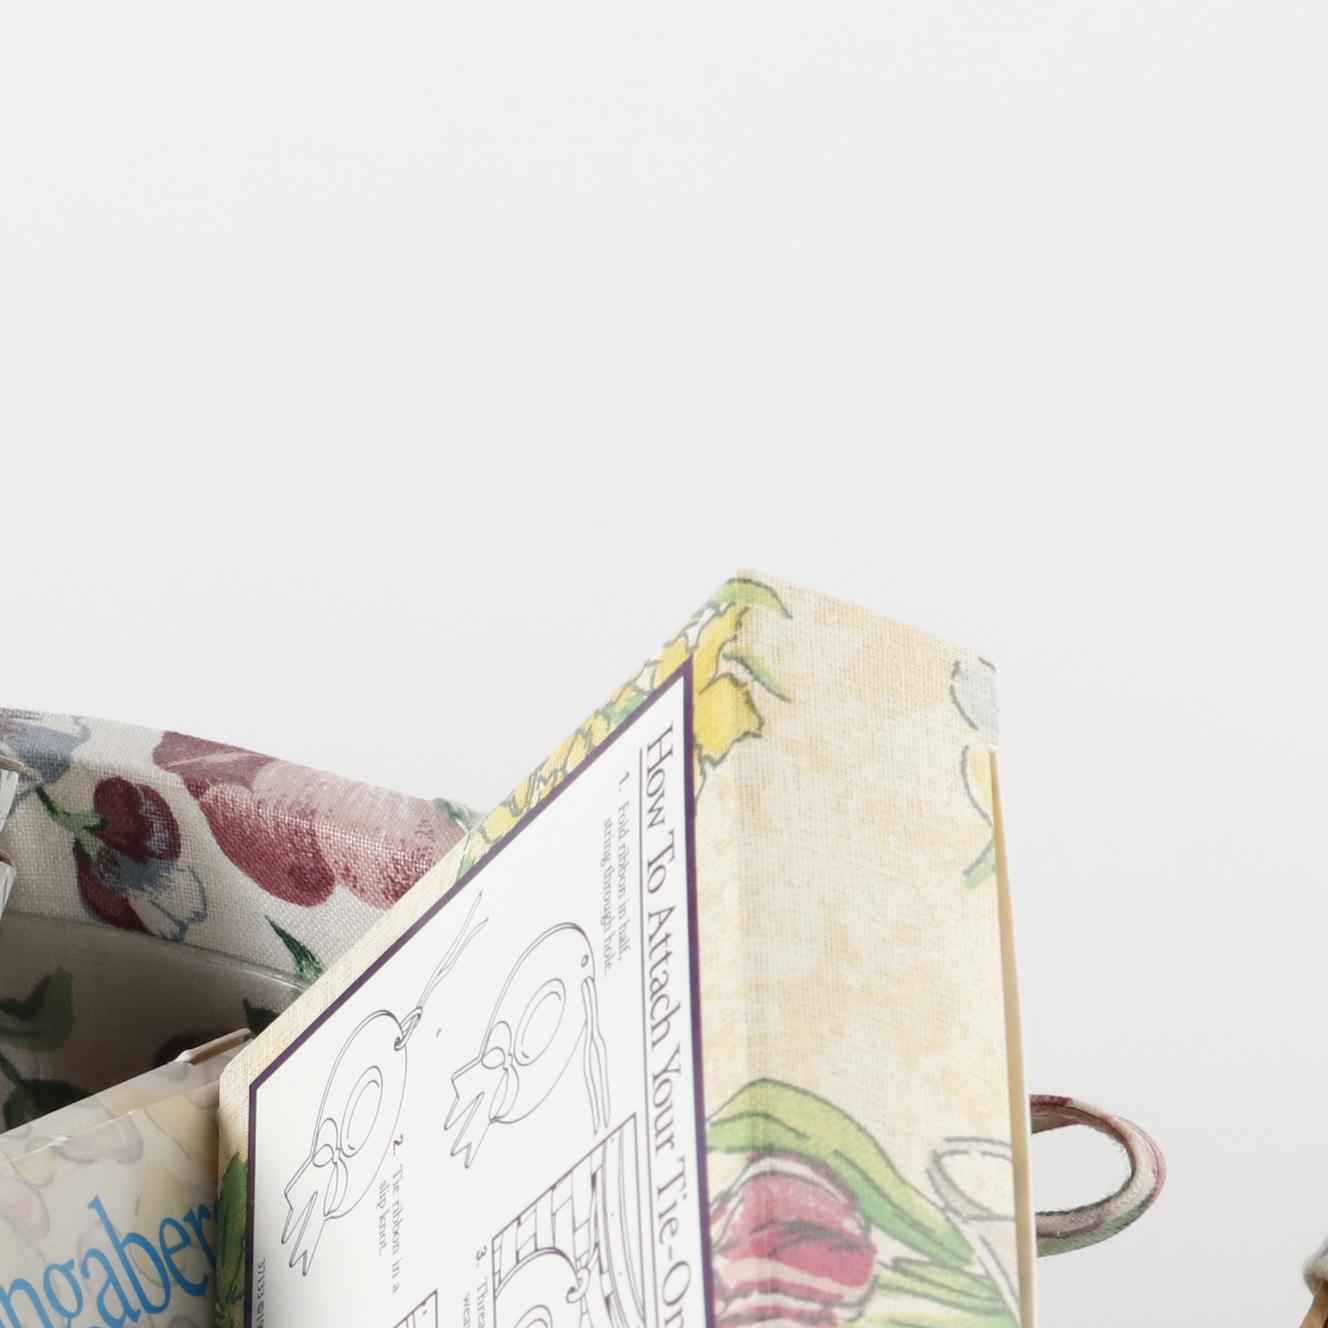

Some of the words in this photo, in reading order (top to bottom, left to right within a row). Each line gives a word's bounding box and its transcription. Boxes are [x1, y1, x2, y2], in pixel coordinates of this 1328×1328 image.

[646, 723, 673, 829] How
[617, 800, 630, 838] Fold
[600, 816, 613, 867] string
[647, 829, 676, 895] To
[617, 842, 630, 896] ribbon
[600, 866, 615, 936] through
[617, 897, 630, 916] in
[648, 905, 681, 1049] Attach
[652, 1042, 681, 1158] Your
[392, 1134, 404, 1157] 2.
[376, 1179, 390, 1209] slip
[392, 1164, 404, 1196] Tie
[392, 1200, 404, 1256] ribbon
[392, 1257, 403, 1279] in
[476, 1245, 487, 1269] 3.
[392, 1281, 400, 1294] a
